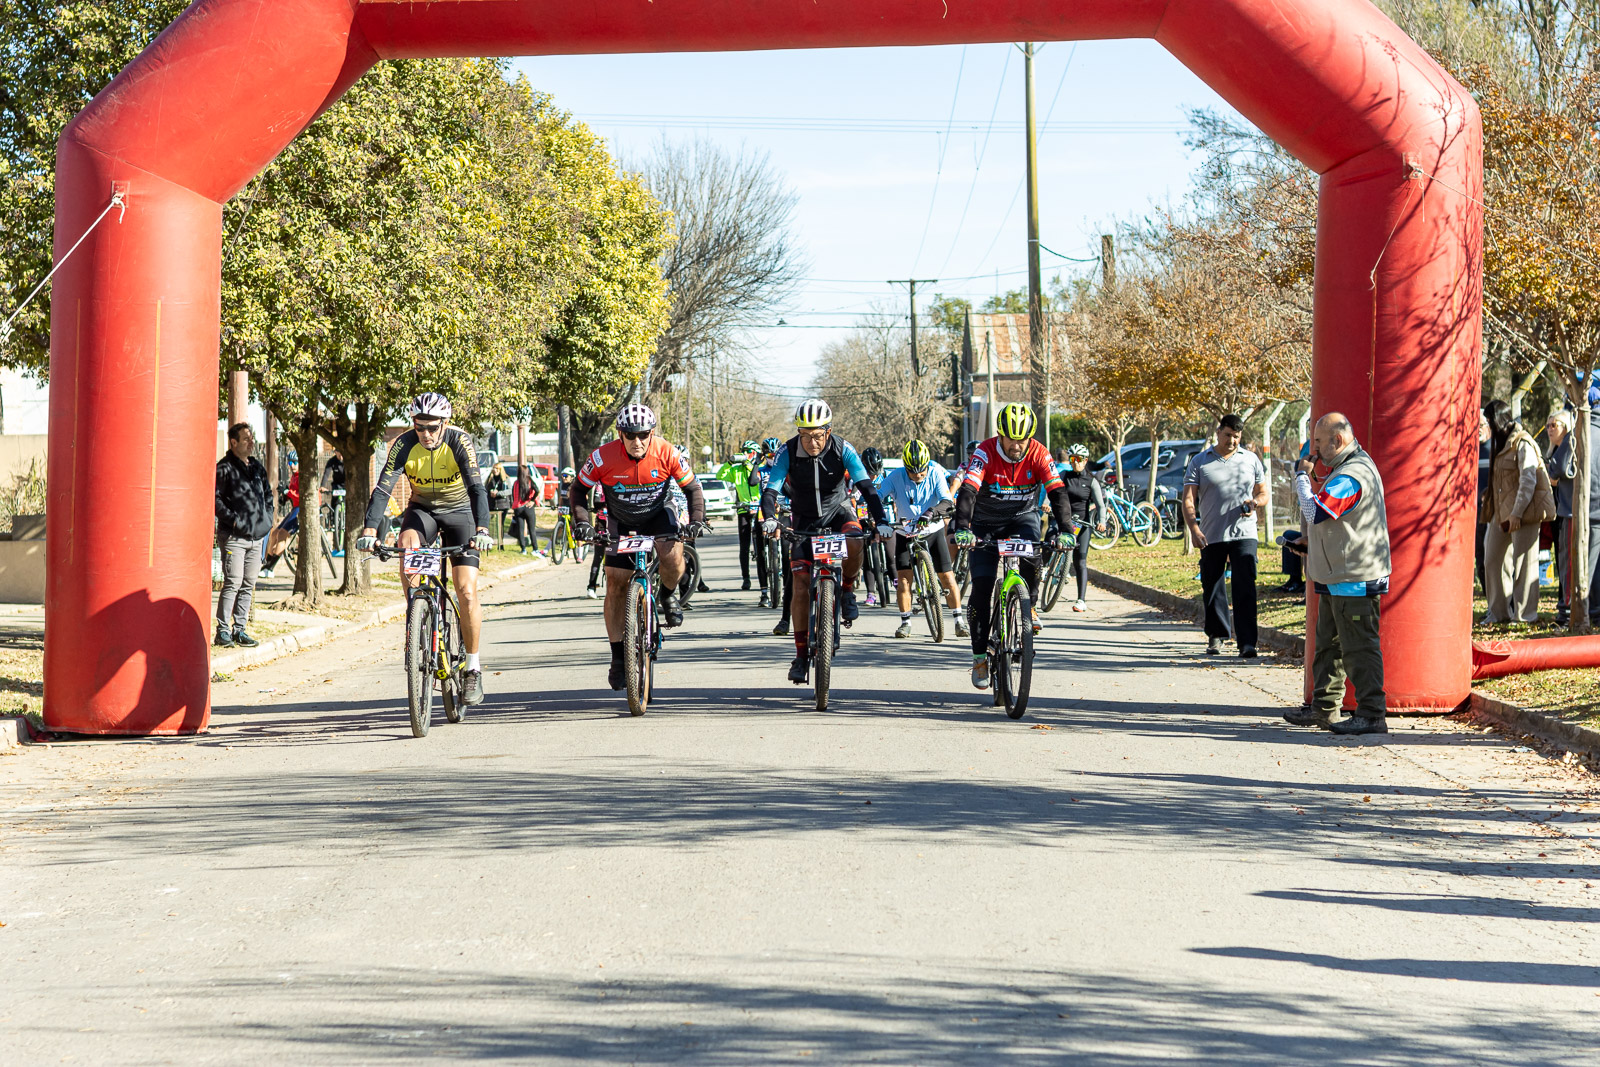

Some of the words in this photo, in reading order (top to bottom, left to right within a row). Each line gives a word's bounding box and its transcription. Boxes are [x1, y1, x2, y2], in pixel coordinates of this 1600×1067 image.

[459, 433, 478, 468] MAXIBIKE
[384, 439, 404, 476] MAXIBIKE
[626, 540, 644, 548] 13
[815, 541, 842, 553] 213
[1004, 543, 1027, 551] 30
[410, 555, 434, 568] 65
